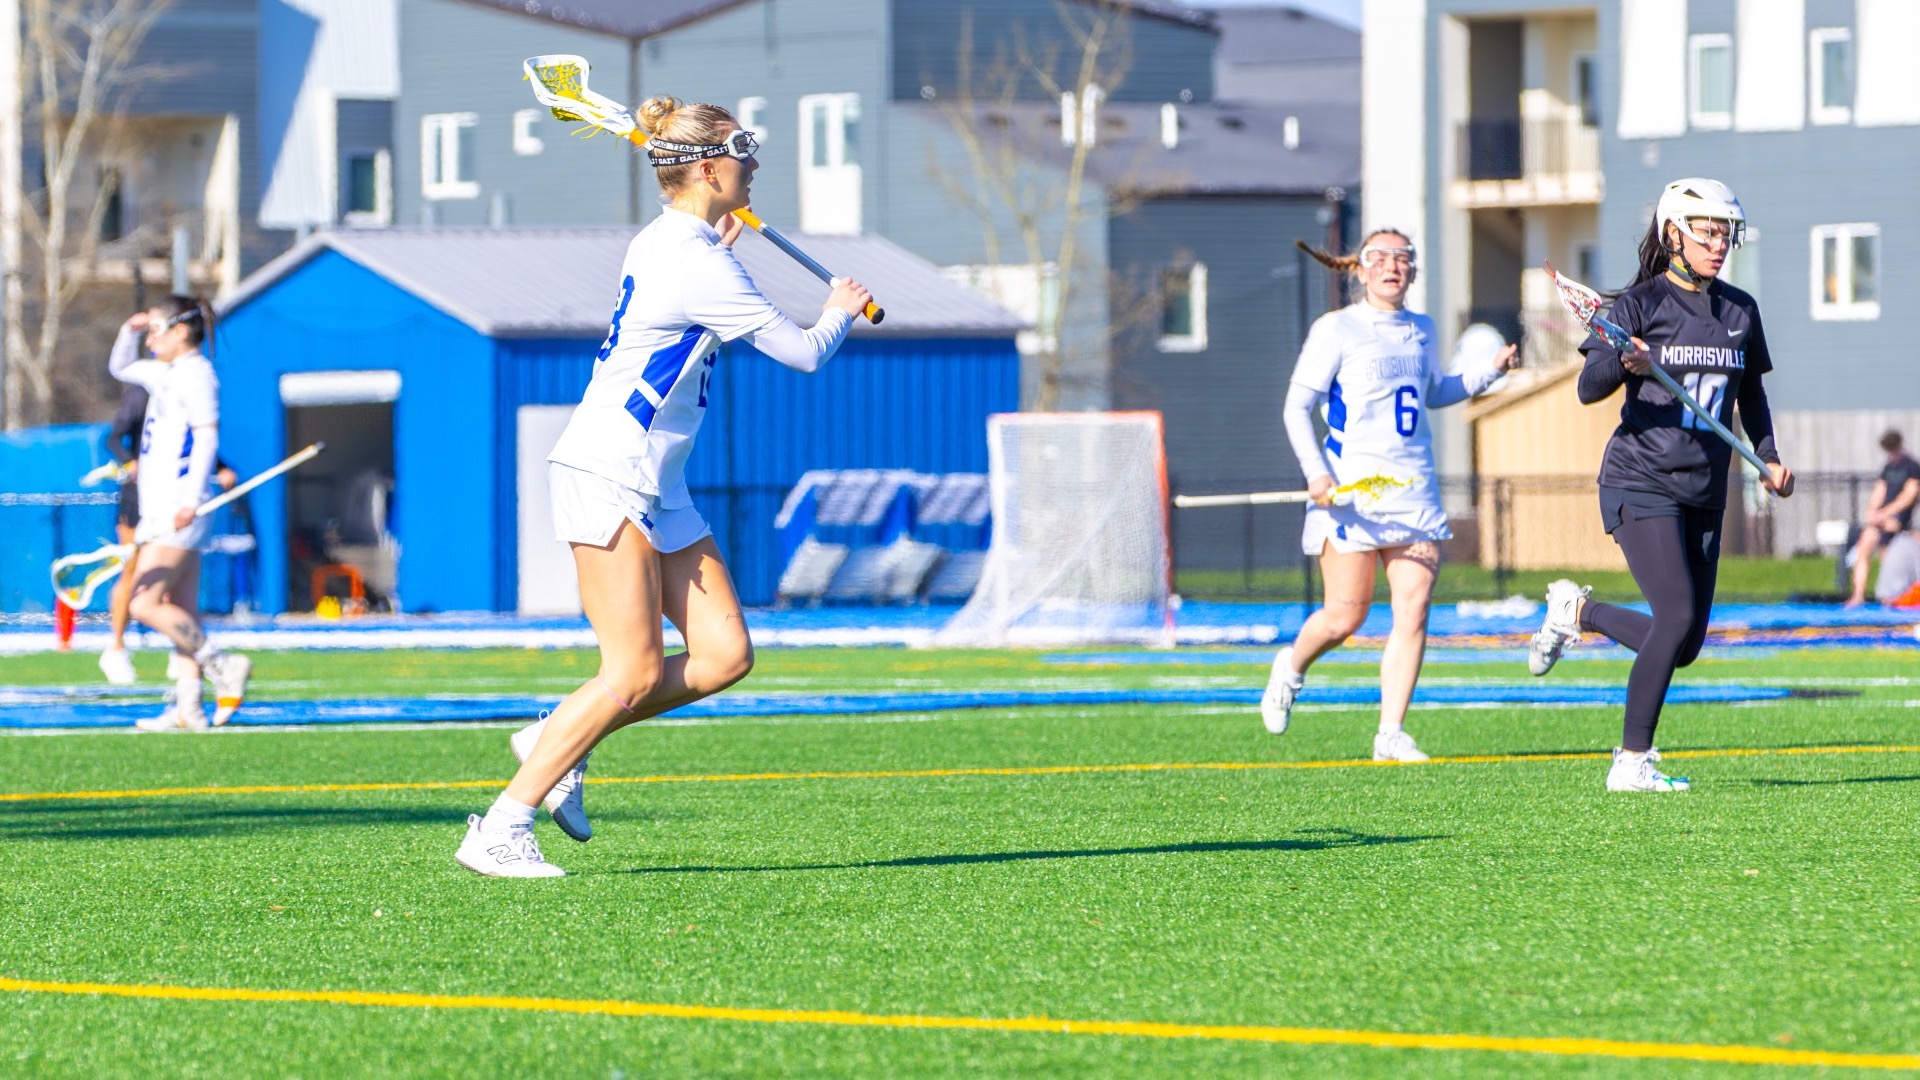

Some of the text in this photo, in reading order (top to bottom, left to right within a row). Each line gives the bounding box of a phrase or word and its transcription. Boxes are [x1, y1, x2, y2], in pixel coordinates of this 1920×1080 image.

[679, 153, 703, 163] GAIT
[706, 145, 728, 157] GAIT
[1661, 345, 1745, 369] MORRISVILLE
[1395, 385, 1418, 437] 6
[1681, 372, 1728, 431] 10
